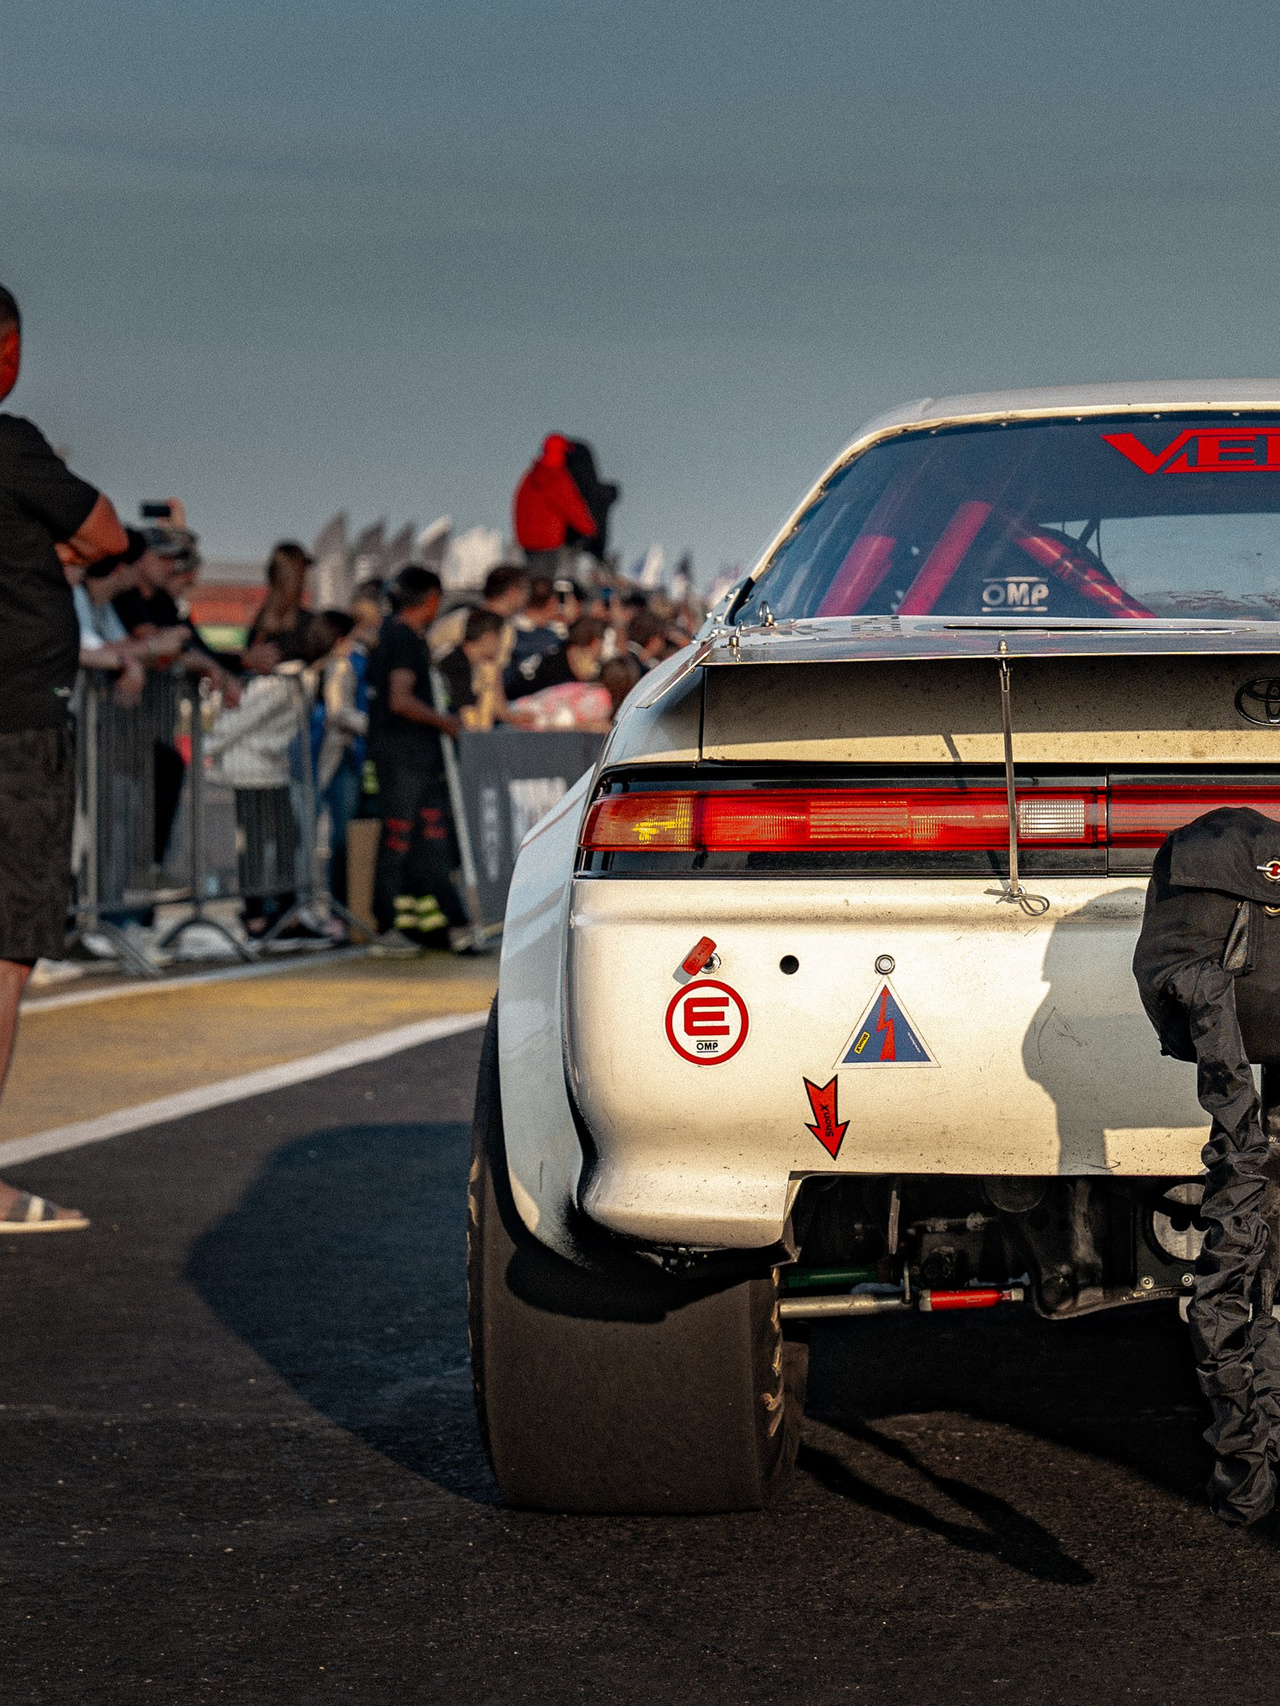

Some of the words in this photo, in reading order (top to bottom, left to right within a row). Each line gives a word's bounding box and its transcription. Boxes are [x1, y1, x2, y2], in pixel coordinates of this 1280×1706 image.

[982, 582, 1049, 606] OMP
[696, 1042, 719, 1051] OMP
[820, 1104, 834, 1137] ShonX
